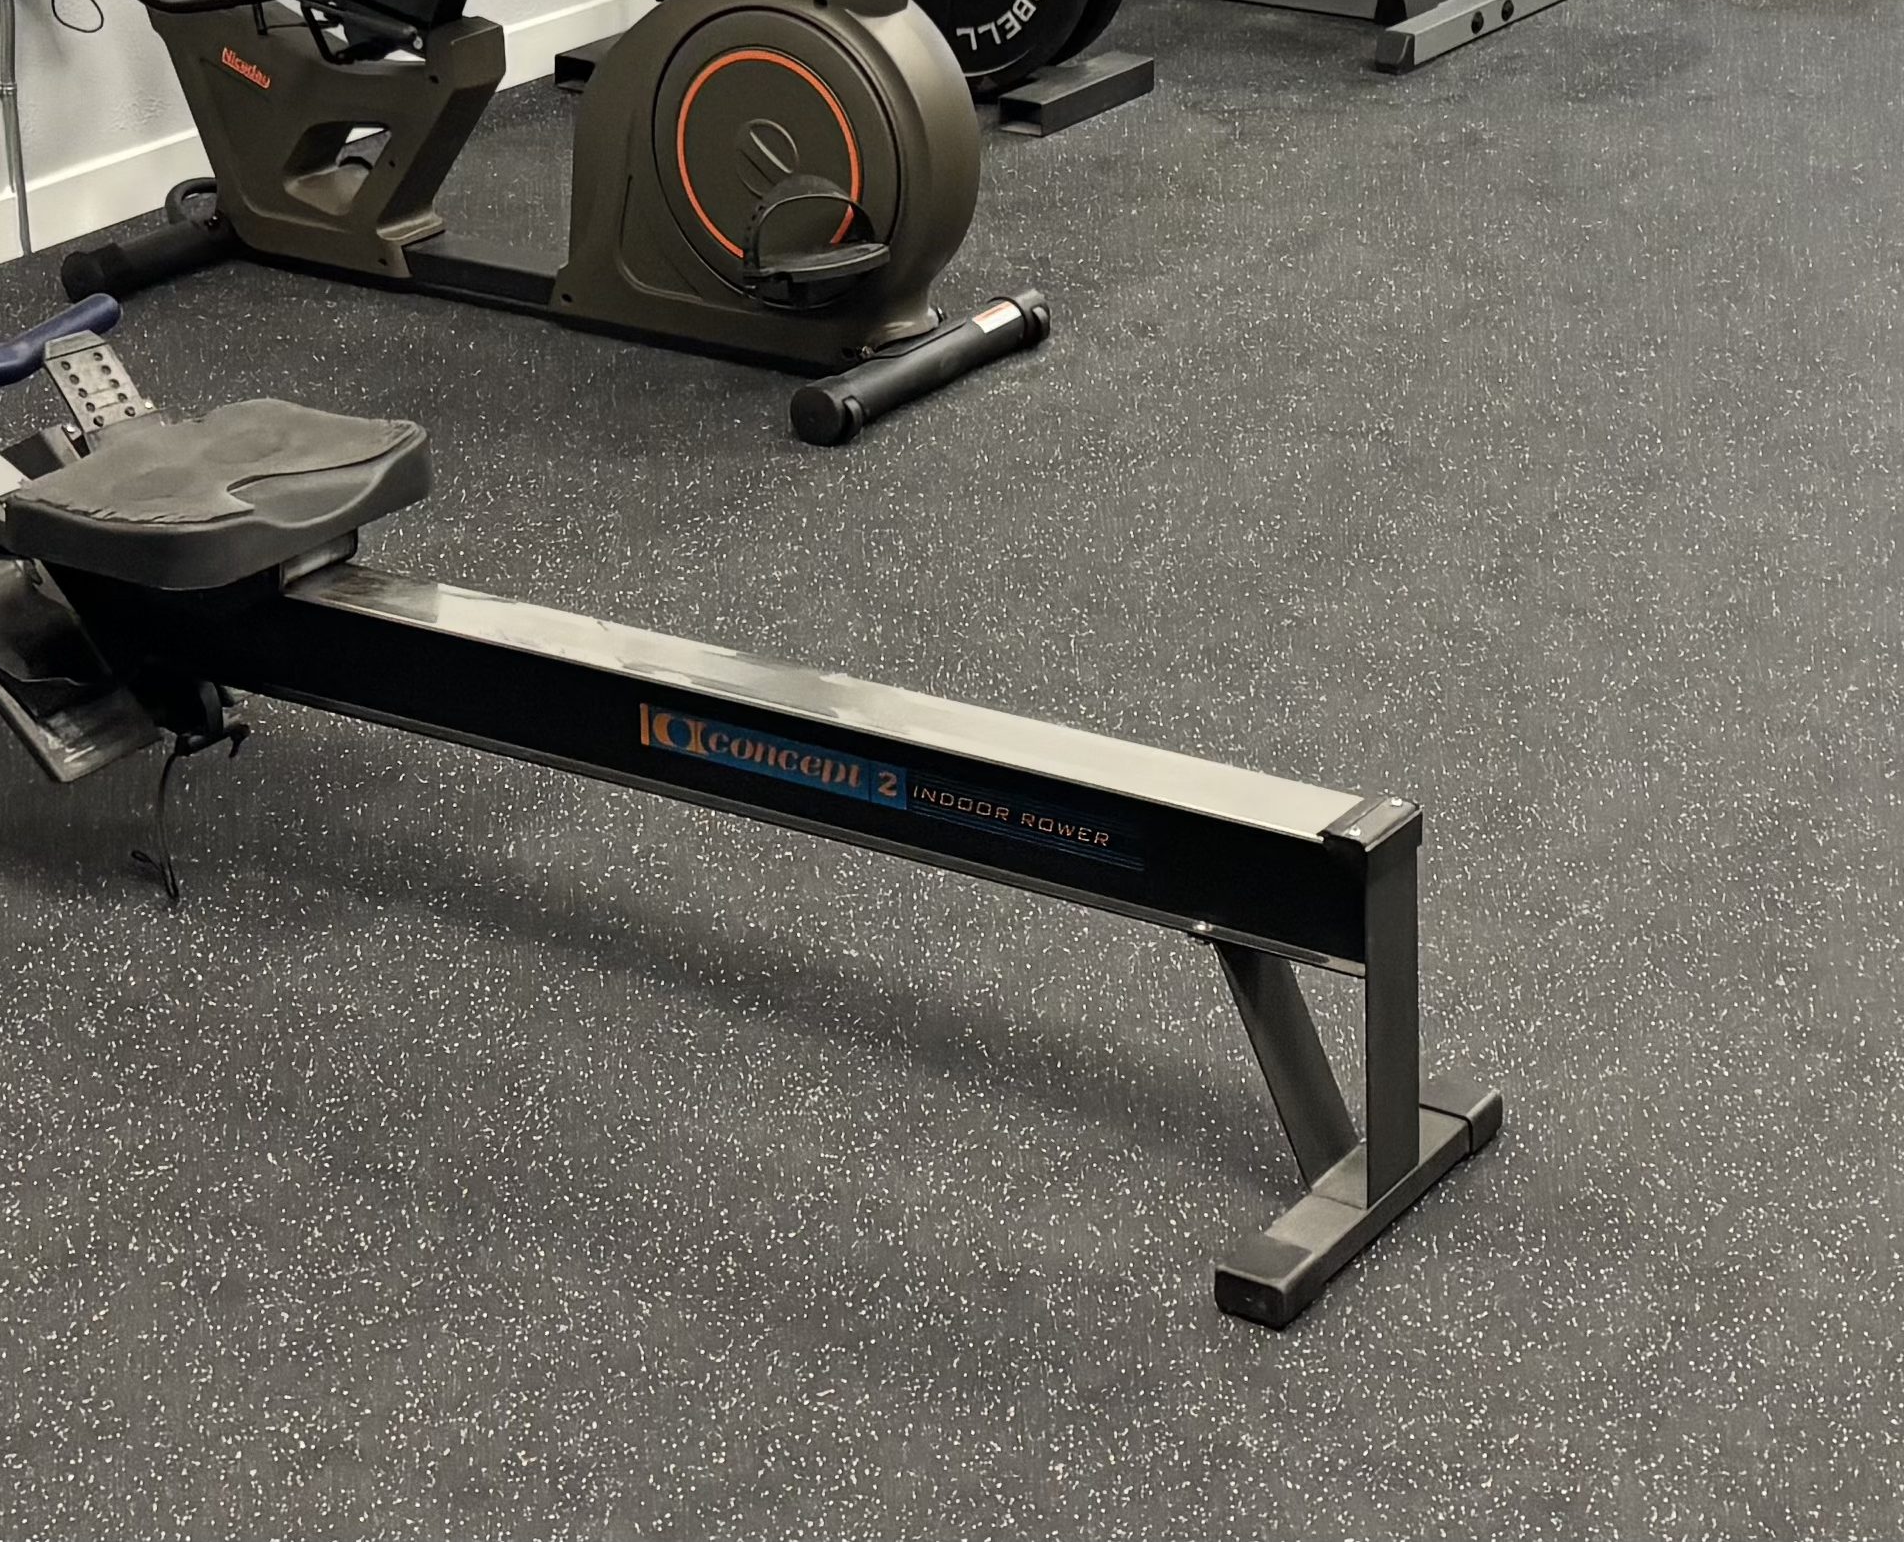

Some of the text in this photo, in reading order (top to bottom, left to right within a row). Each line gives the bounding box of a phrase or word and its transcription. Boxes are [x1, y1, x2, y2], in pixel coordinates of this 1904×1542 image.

[708, 733, 1111, 847] concept 2 INDOOR ROWER
